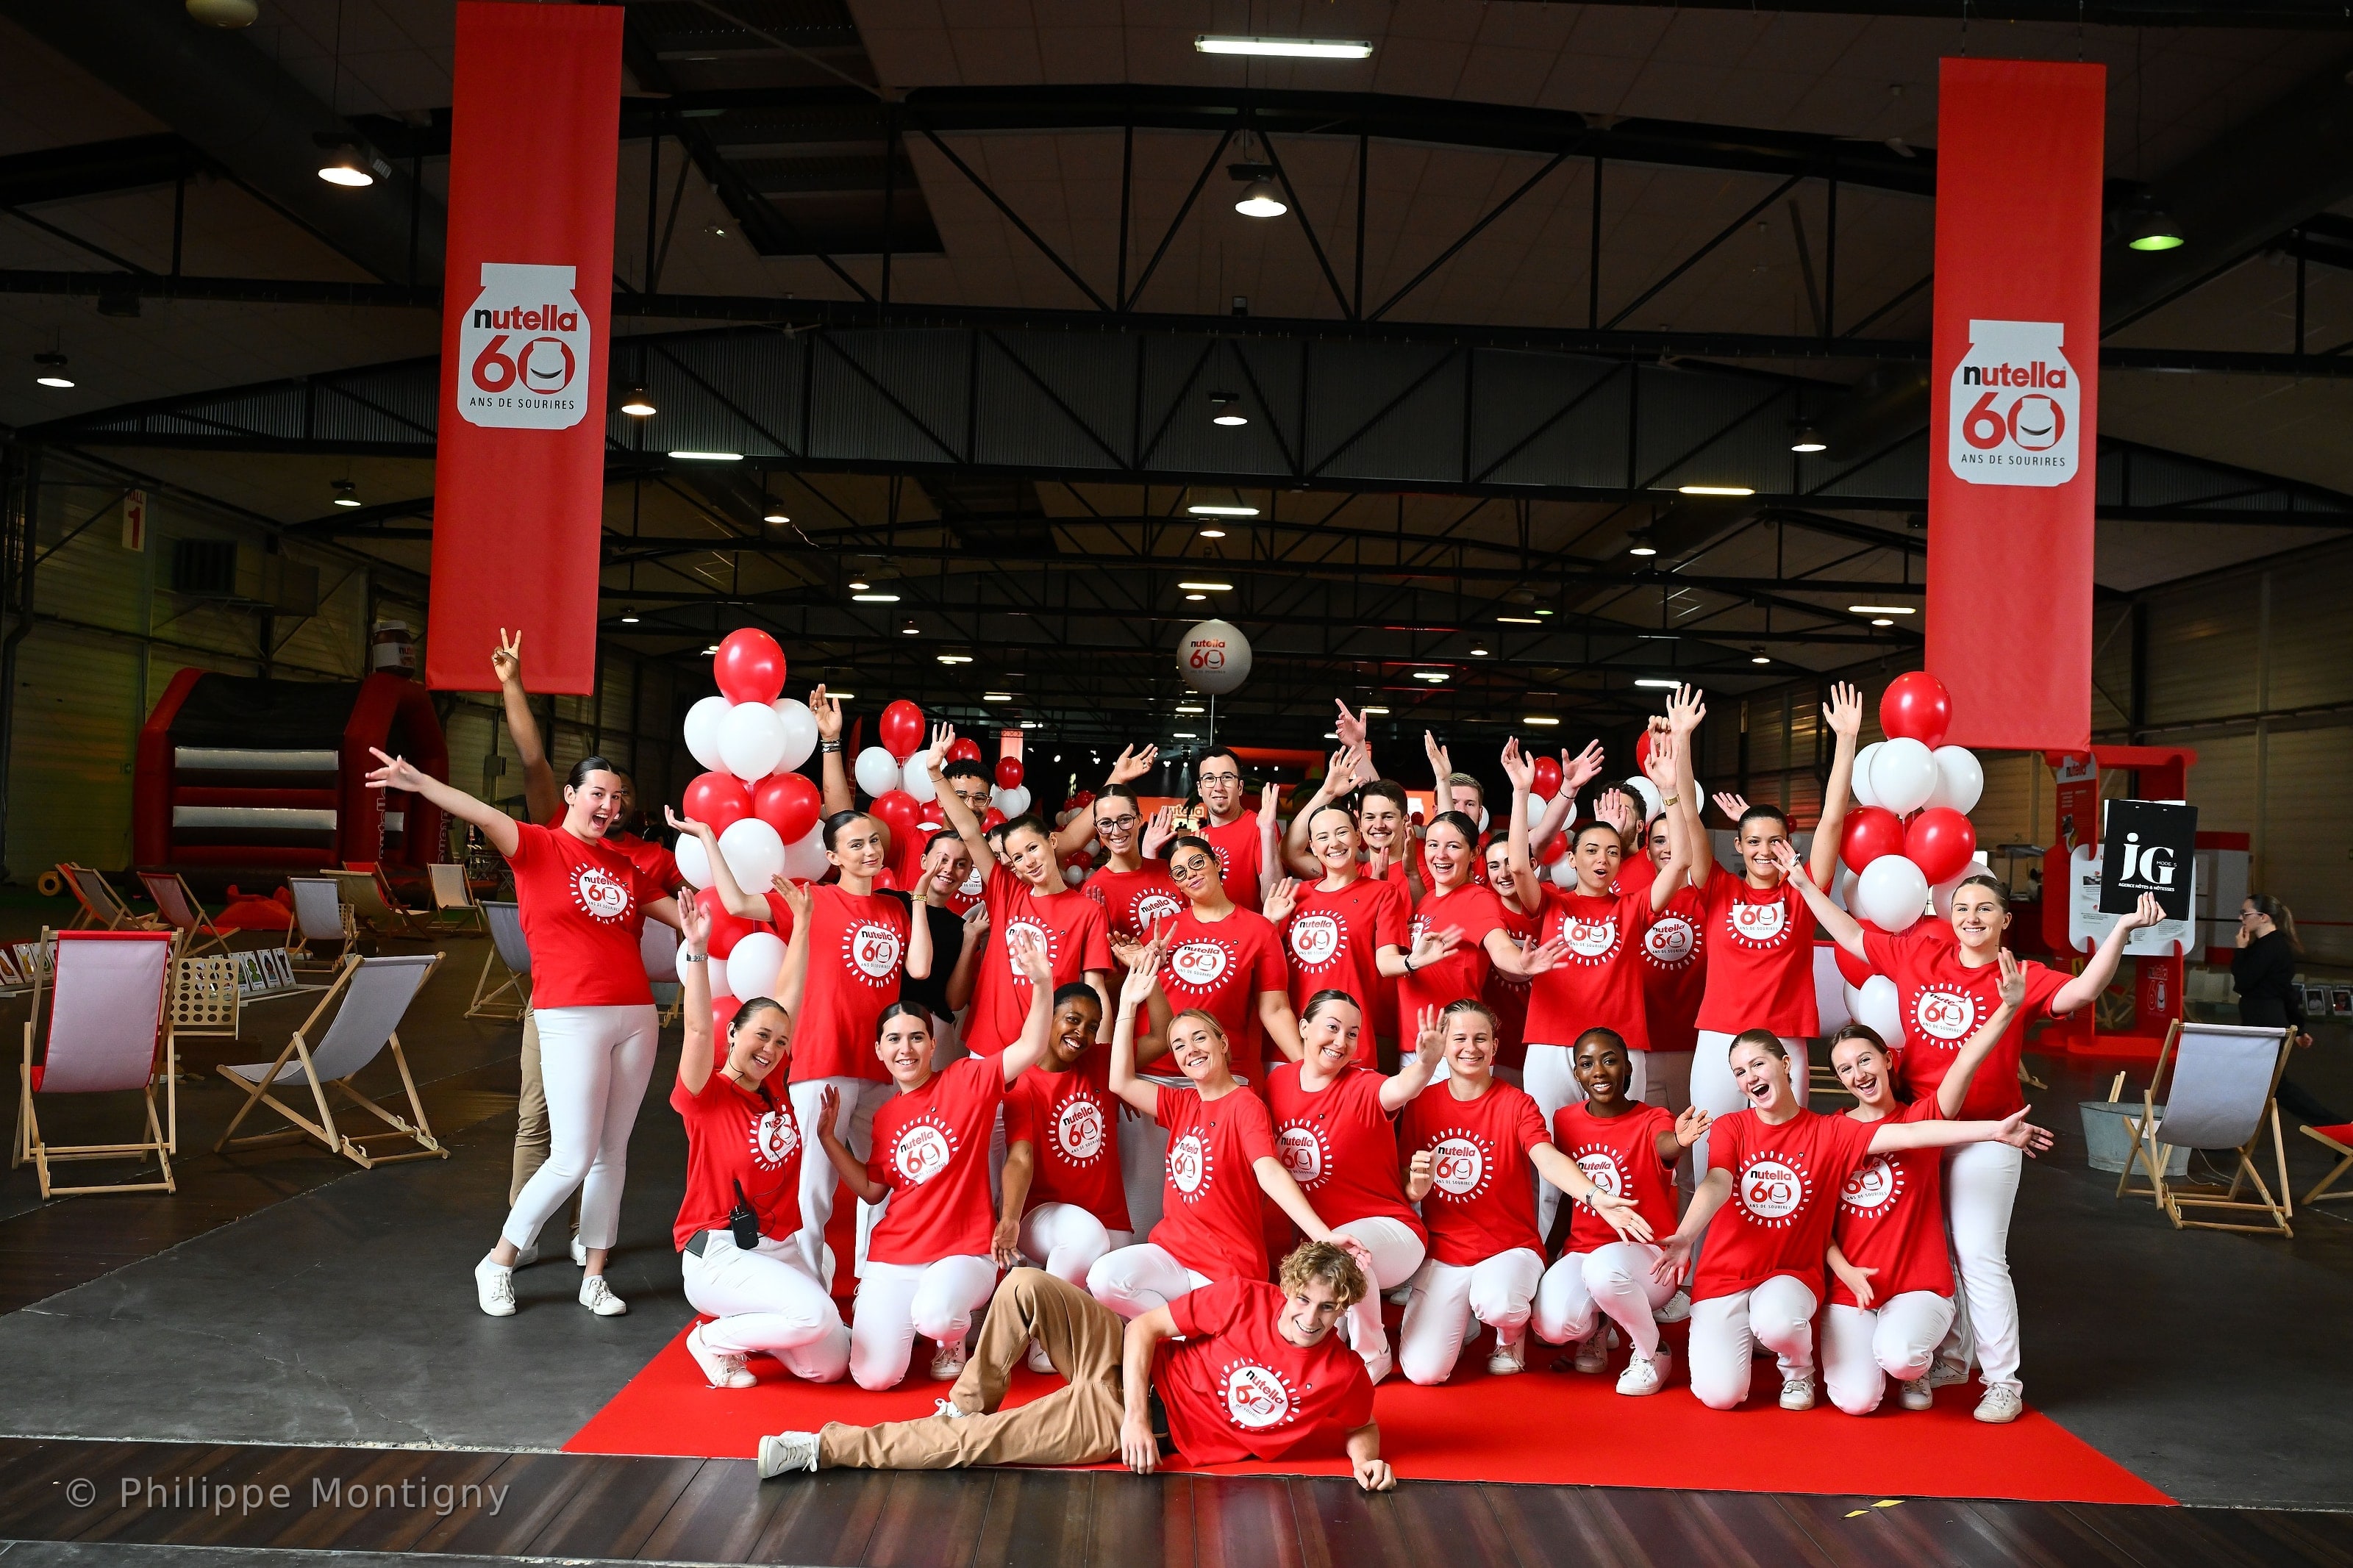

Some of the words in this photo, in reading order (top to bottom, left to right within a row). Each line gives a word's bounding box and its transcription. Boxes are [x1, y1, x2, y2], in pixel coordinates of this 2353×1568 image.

[474, 304, 577, 332] nutella
[471, 334, 576, 395] 60
[1963, 361, 2065, 389] nutella
[470, 397, 493, 407] ANS
[499, 398, 512, 407] DE
[518, 398, 575, 409] SOURIRES
[1963, 392, 2065, 451] 60
[1961, 454, 1983, 463] ANS
[1989, 454, 2002, 464] DE
[2009, 456, 2065, 466] SOURIRES
[128, 506, 140, 548] 1
[1190, 649, 1225, 669] 60
[2120, 832, 2176, 884] jG
[588, 884, 620, 905] 60
[1141, 899, 1170, 912] nutella
[1740, 906, 1777, 925] 60
[862, 931, 893, 940] nutella
[1299, 930, 1329, 950] 60
[1571, 924, 1607, 942] 60
[1652, 931, 1685, 948] 60
[862, 940, 892, 963] 60
[1185, 946, 1220, 954] nutella
[1180, 953, 1216, 971] 60
[1925, 1001, 1963, 1025] 60
[1063, 1106, 1093, 1125] nutella
[901, 1131, 934, 1153] nutella
[1069, 1118, 1098, 1147] 60
[1281, 1136, 1313, 1147] nutella
[907, 1143, 940, 1173] 60
[1282, 1148, 1313, 1170] 60
[1438, 1146, 1475, 1156] nutella
[1175, 1153, 1195, 1178] 60
[1437, 1157, 1473, 1179] 60
[1579, 1161, 1611, 1170] nutella
[1751, 1170, 1791, 1181] nutella
[1750, 1181, 1791, 1203] 60
[1246, 1370, 1285, 1404] nutella
[1236, 1385, 1275, 1414] 60
